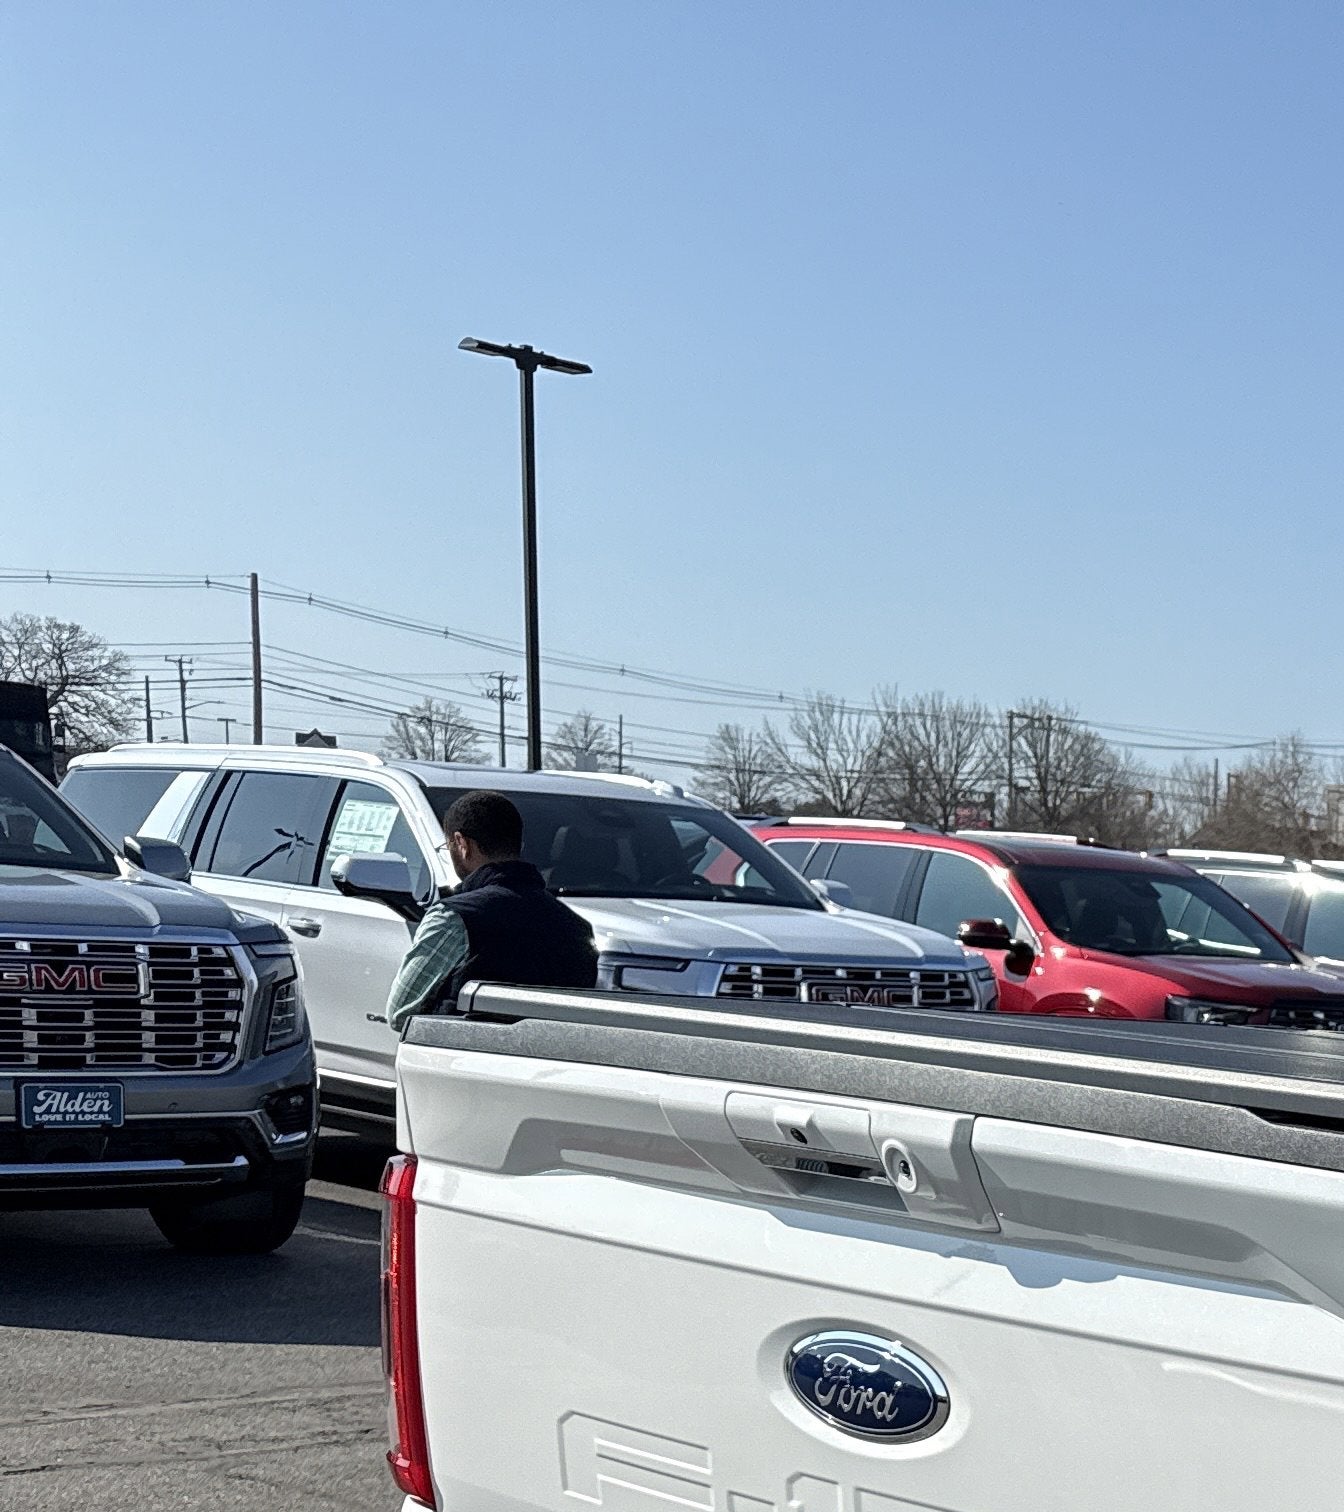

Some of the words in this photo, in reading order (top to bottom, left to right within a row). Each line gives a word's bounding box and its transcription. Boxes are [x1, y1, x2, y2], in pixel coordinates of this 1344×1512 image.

[811, 983, 914, 1007] GMC
[32, 1089, 113, 1114] Alden
[84, 1091, 111, 1099] AUTO
[34, 1113, 64, 1122] LOVE
[65, 1113, 76, 1121] IT
[77, 1113, 112, 1121] LOCAL
[814, 1352, 903, 1422] Ford
